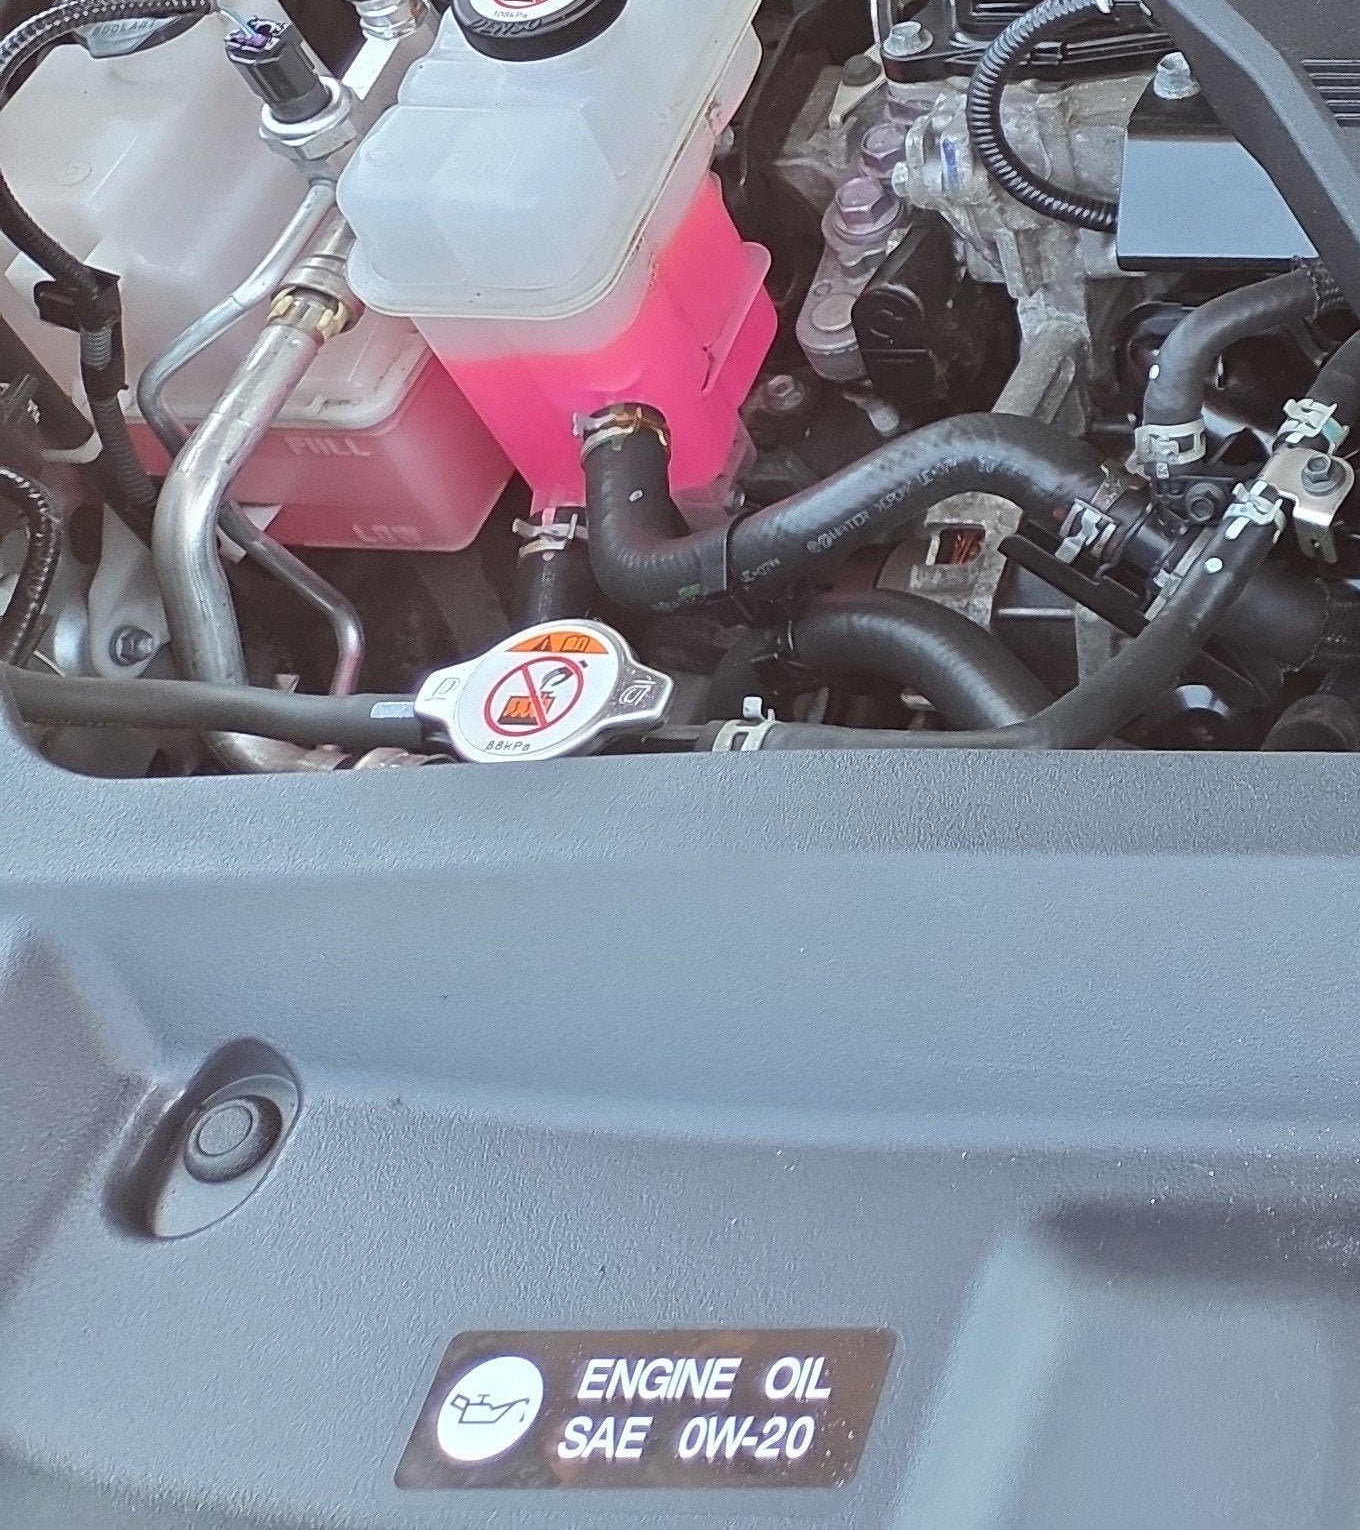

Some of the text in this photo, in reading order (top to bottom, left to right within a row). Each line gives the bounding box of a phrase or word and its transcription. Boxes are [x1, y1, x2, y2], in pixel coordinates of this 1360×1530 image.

[284, 436, 371, 457] FULL
[352, 525, 421, 544] LOW
[485, 740, 531, 752] 88kPa
[577, 1356, 832, 1399] ENGINE OIL
[557, 1416, 815, 1459] SAE 0W-20
